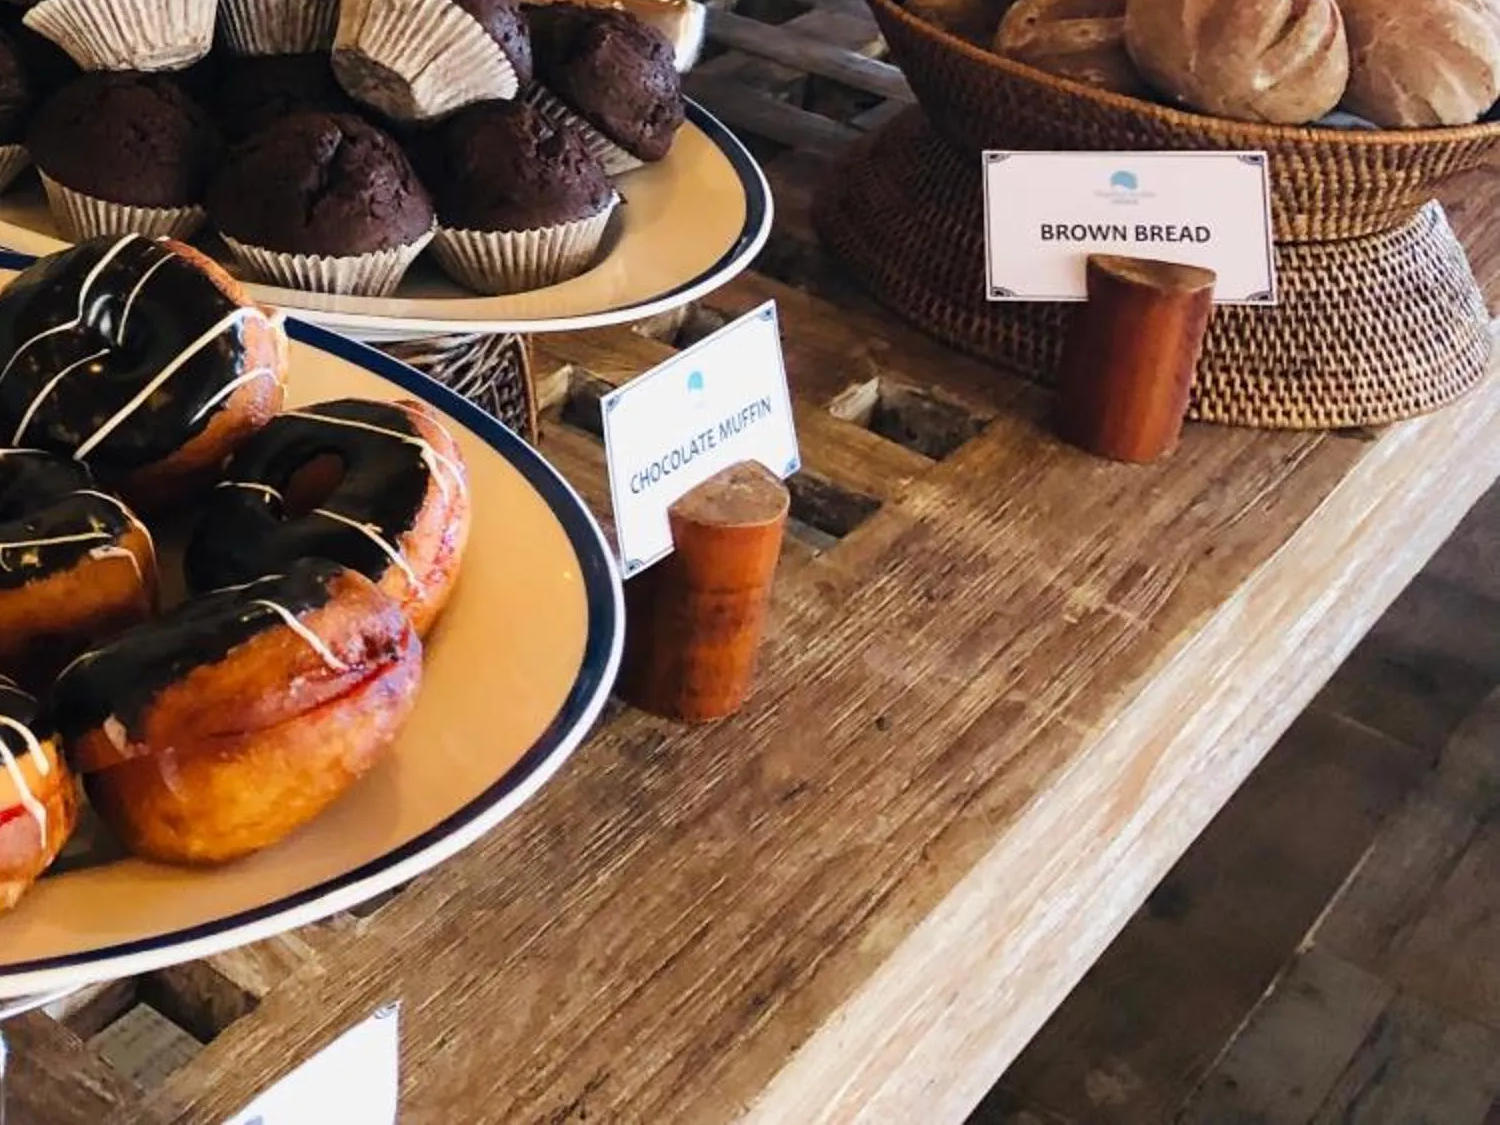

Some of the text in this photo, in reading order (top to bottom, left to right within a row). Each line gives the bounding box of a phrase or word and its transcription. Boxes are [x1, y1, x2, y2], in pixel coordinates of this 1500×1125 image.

[1040, 224, 1211, 244] BROWN BREAD
[629, 394, 772, 494] CHOCOLATE MUFFIN
